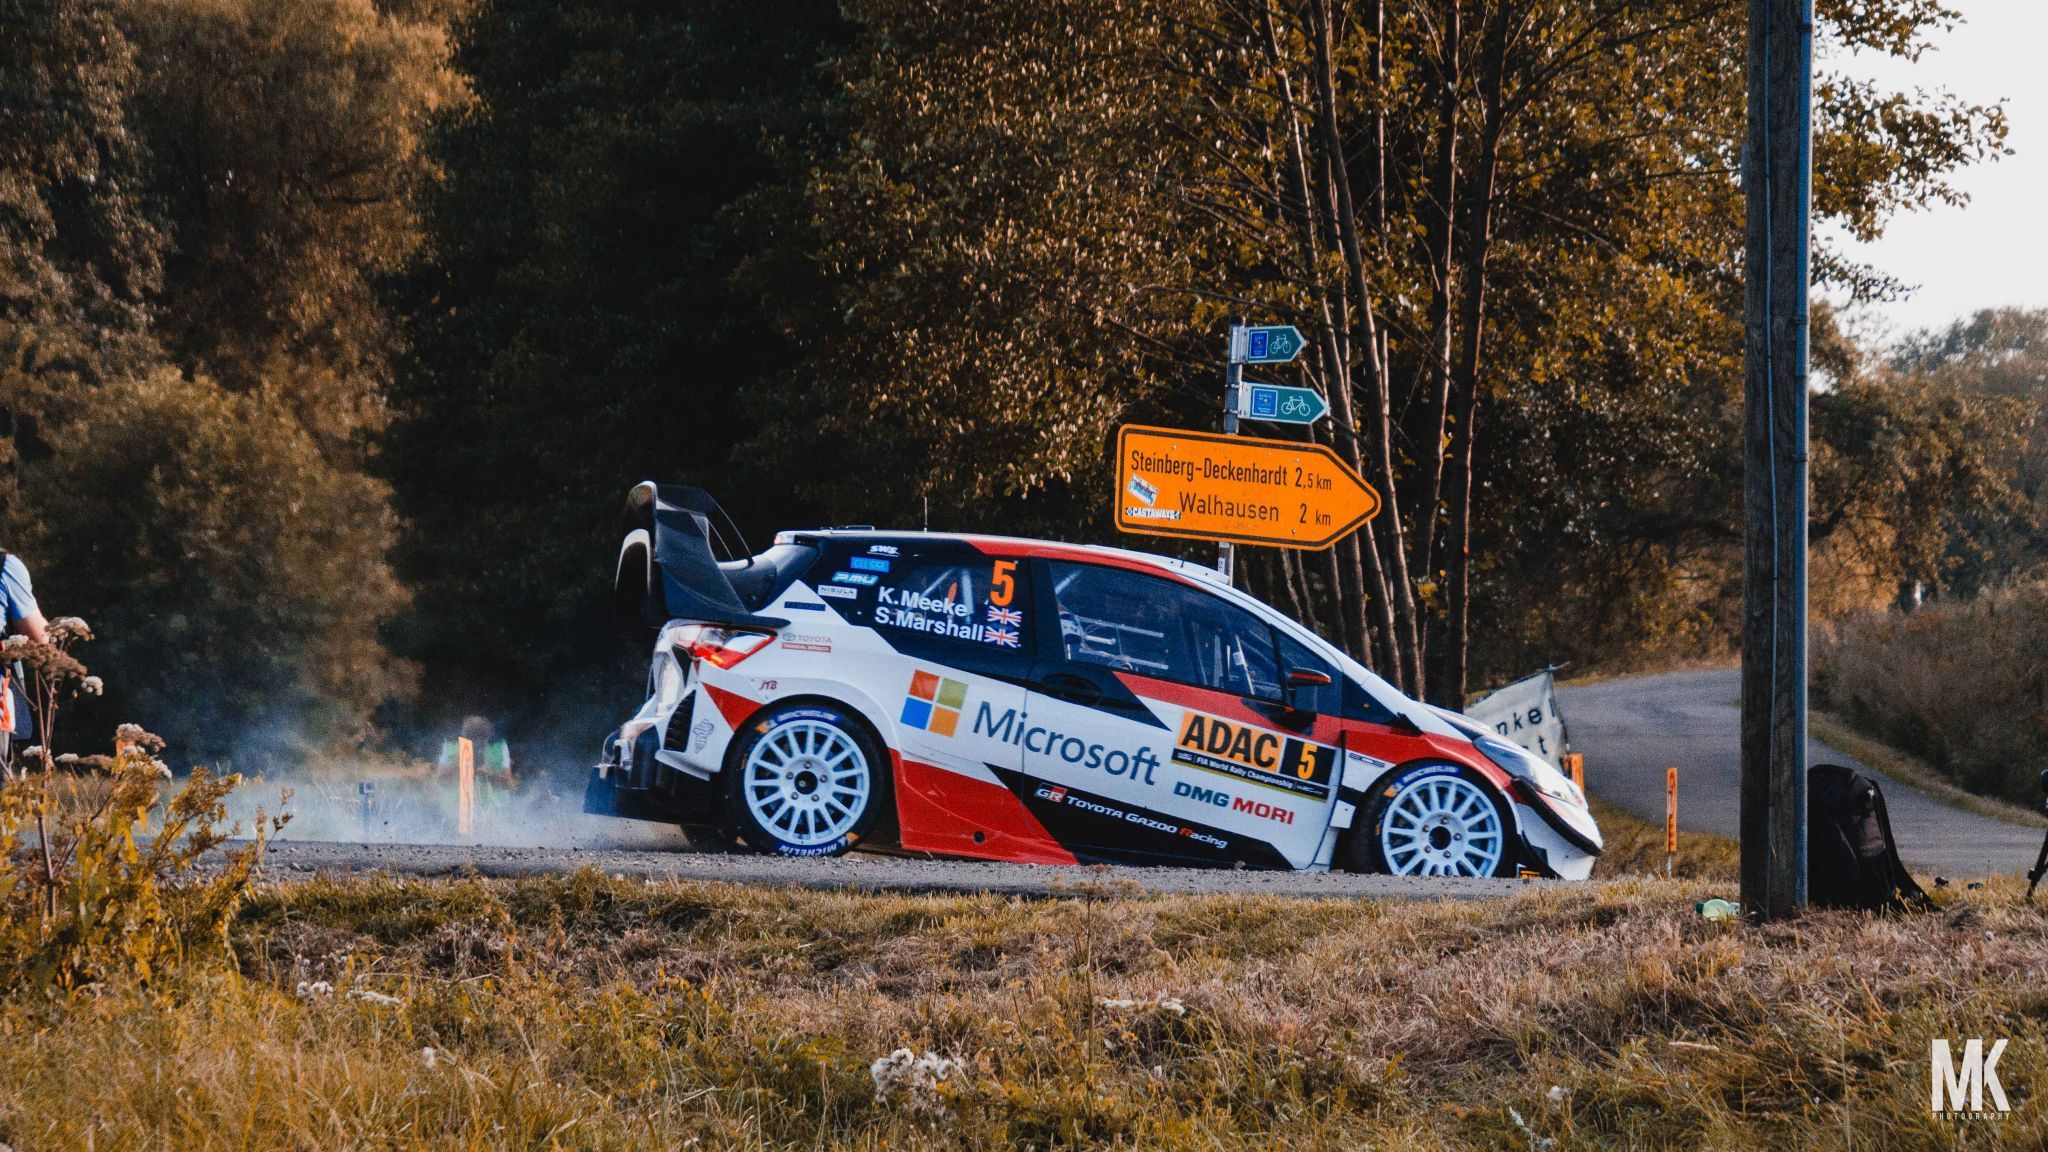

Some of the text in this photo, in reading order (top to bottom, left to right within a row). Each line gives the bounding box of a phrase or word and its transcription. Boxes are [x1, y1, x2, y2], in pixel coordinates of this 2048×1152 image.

[1131, 450, 1332, 491] Steinberg-Deckenhardt 2,5 km
[1179, 490, 1279, 522] Walhausen
[1299, 503, 1308, 524] 2
[1315, 509, 1331, 526] km
[878, 585, 968, 617] K.Meeke
[990, 559, 1017, 607] 5
[797, 634, 832, 644] TOYOTA
[874, 606, 984, 641] S.Marshall
[973, 700, 1161, 786] Microsoft
[1181, 714, 1318, 780] ADAC 5
[1209, 759, 1228, 772] World
[1229, 765, 1247, 778] Rally
[1247, 769, 1294, 791] Championship
[1173, 781, 1296, 825] DMG MORI
[1067, 796, 1123, 819] TOYOTA
[1125, 812, 1178, 834] GAZOO
[1179, 826, 1229, 849] Racing
[778, 843, 838, 858] MICHELIN
